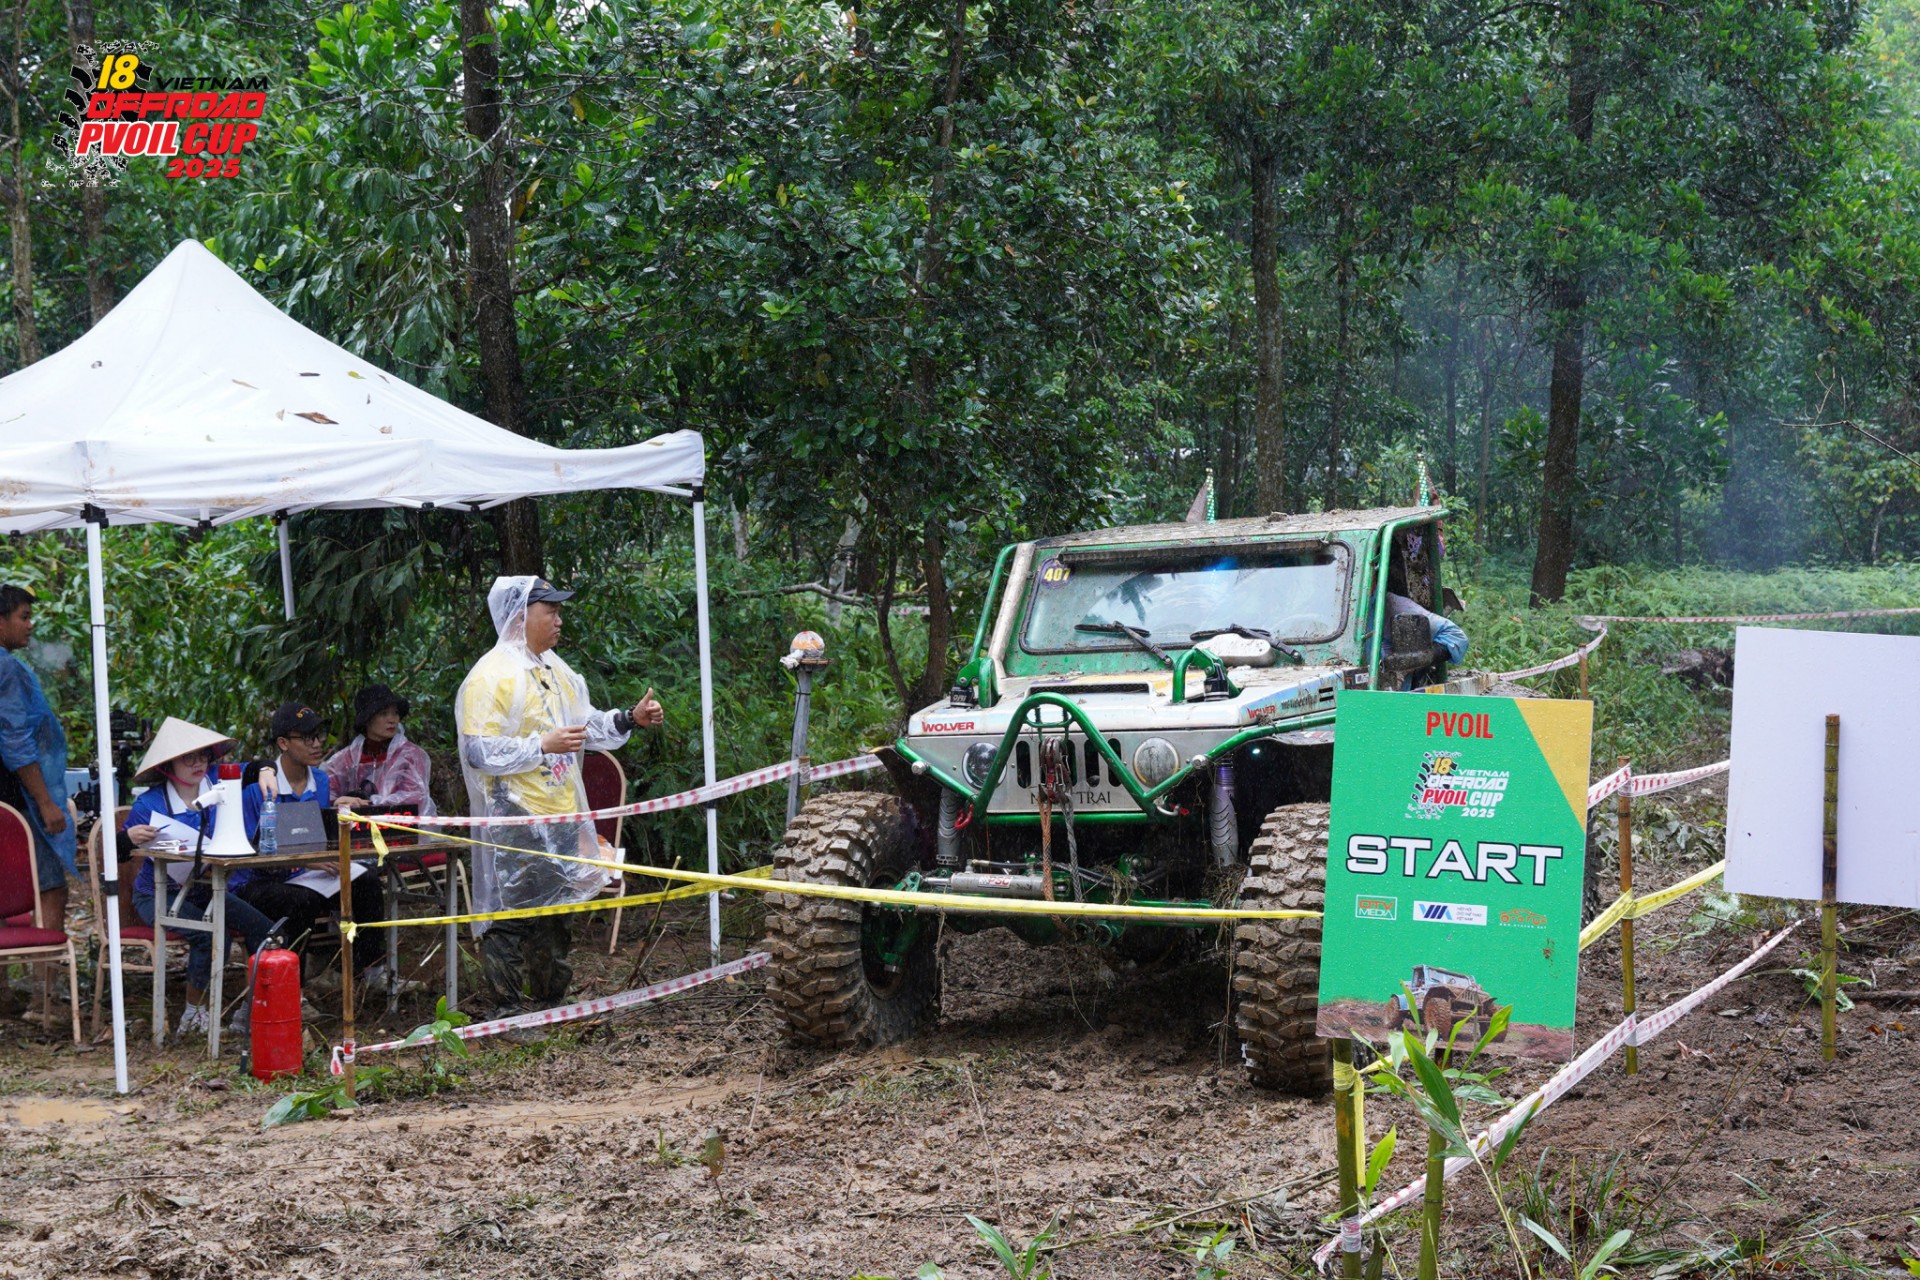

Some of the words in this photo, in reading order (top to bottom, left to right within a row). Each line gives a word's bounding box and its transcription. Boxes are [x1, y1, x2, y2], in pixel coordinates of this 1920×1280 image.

[1044, 567, 1071, 582] 407
[921, 721, 975, 732] WOLVER
[1425, 711, 1494, 739] PVOIL
[1432, 757, 1453, 775] 18
[1458, 769, 1510, 778] VIETNAM
[1426, 775, 1509, 791] OFFROAD
[1422, 789, 1469, 806] PVOIL
[1469, 791, 1504, 807] CUP
[1461, 807, 1496, 818] 2025
[1346, 833, 1564, 886] START
[1358, 908, 1394, 919] MEDIA
